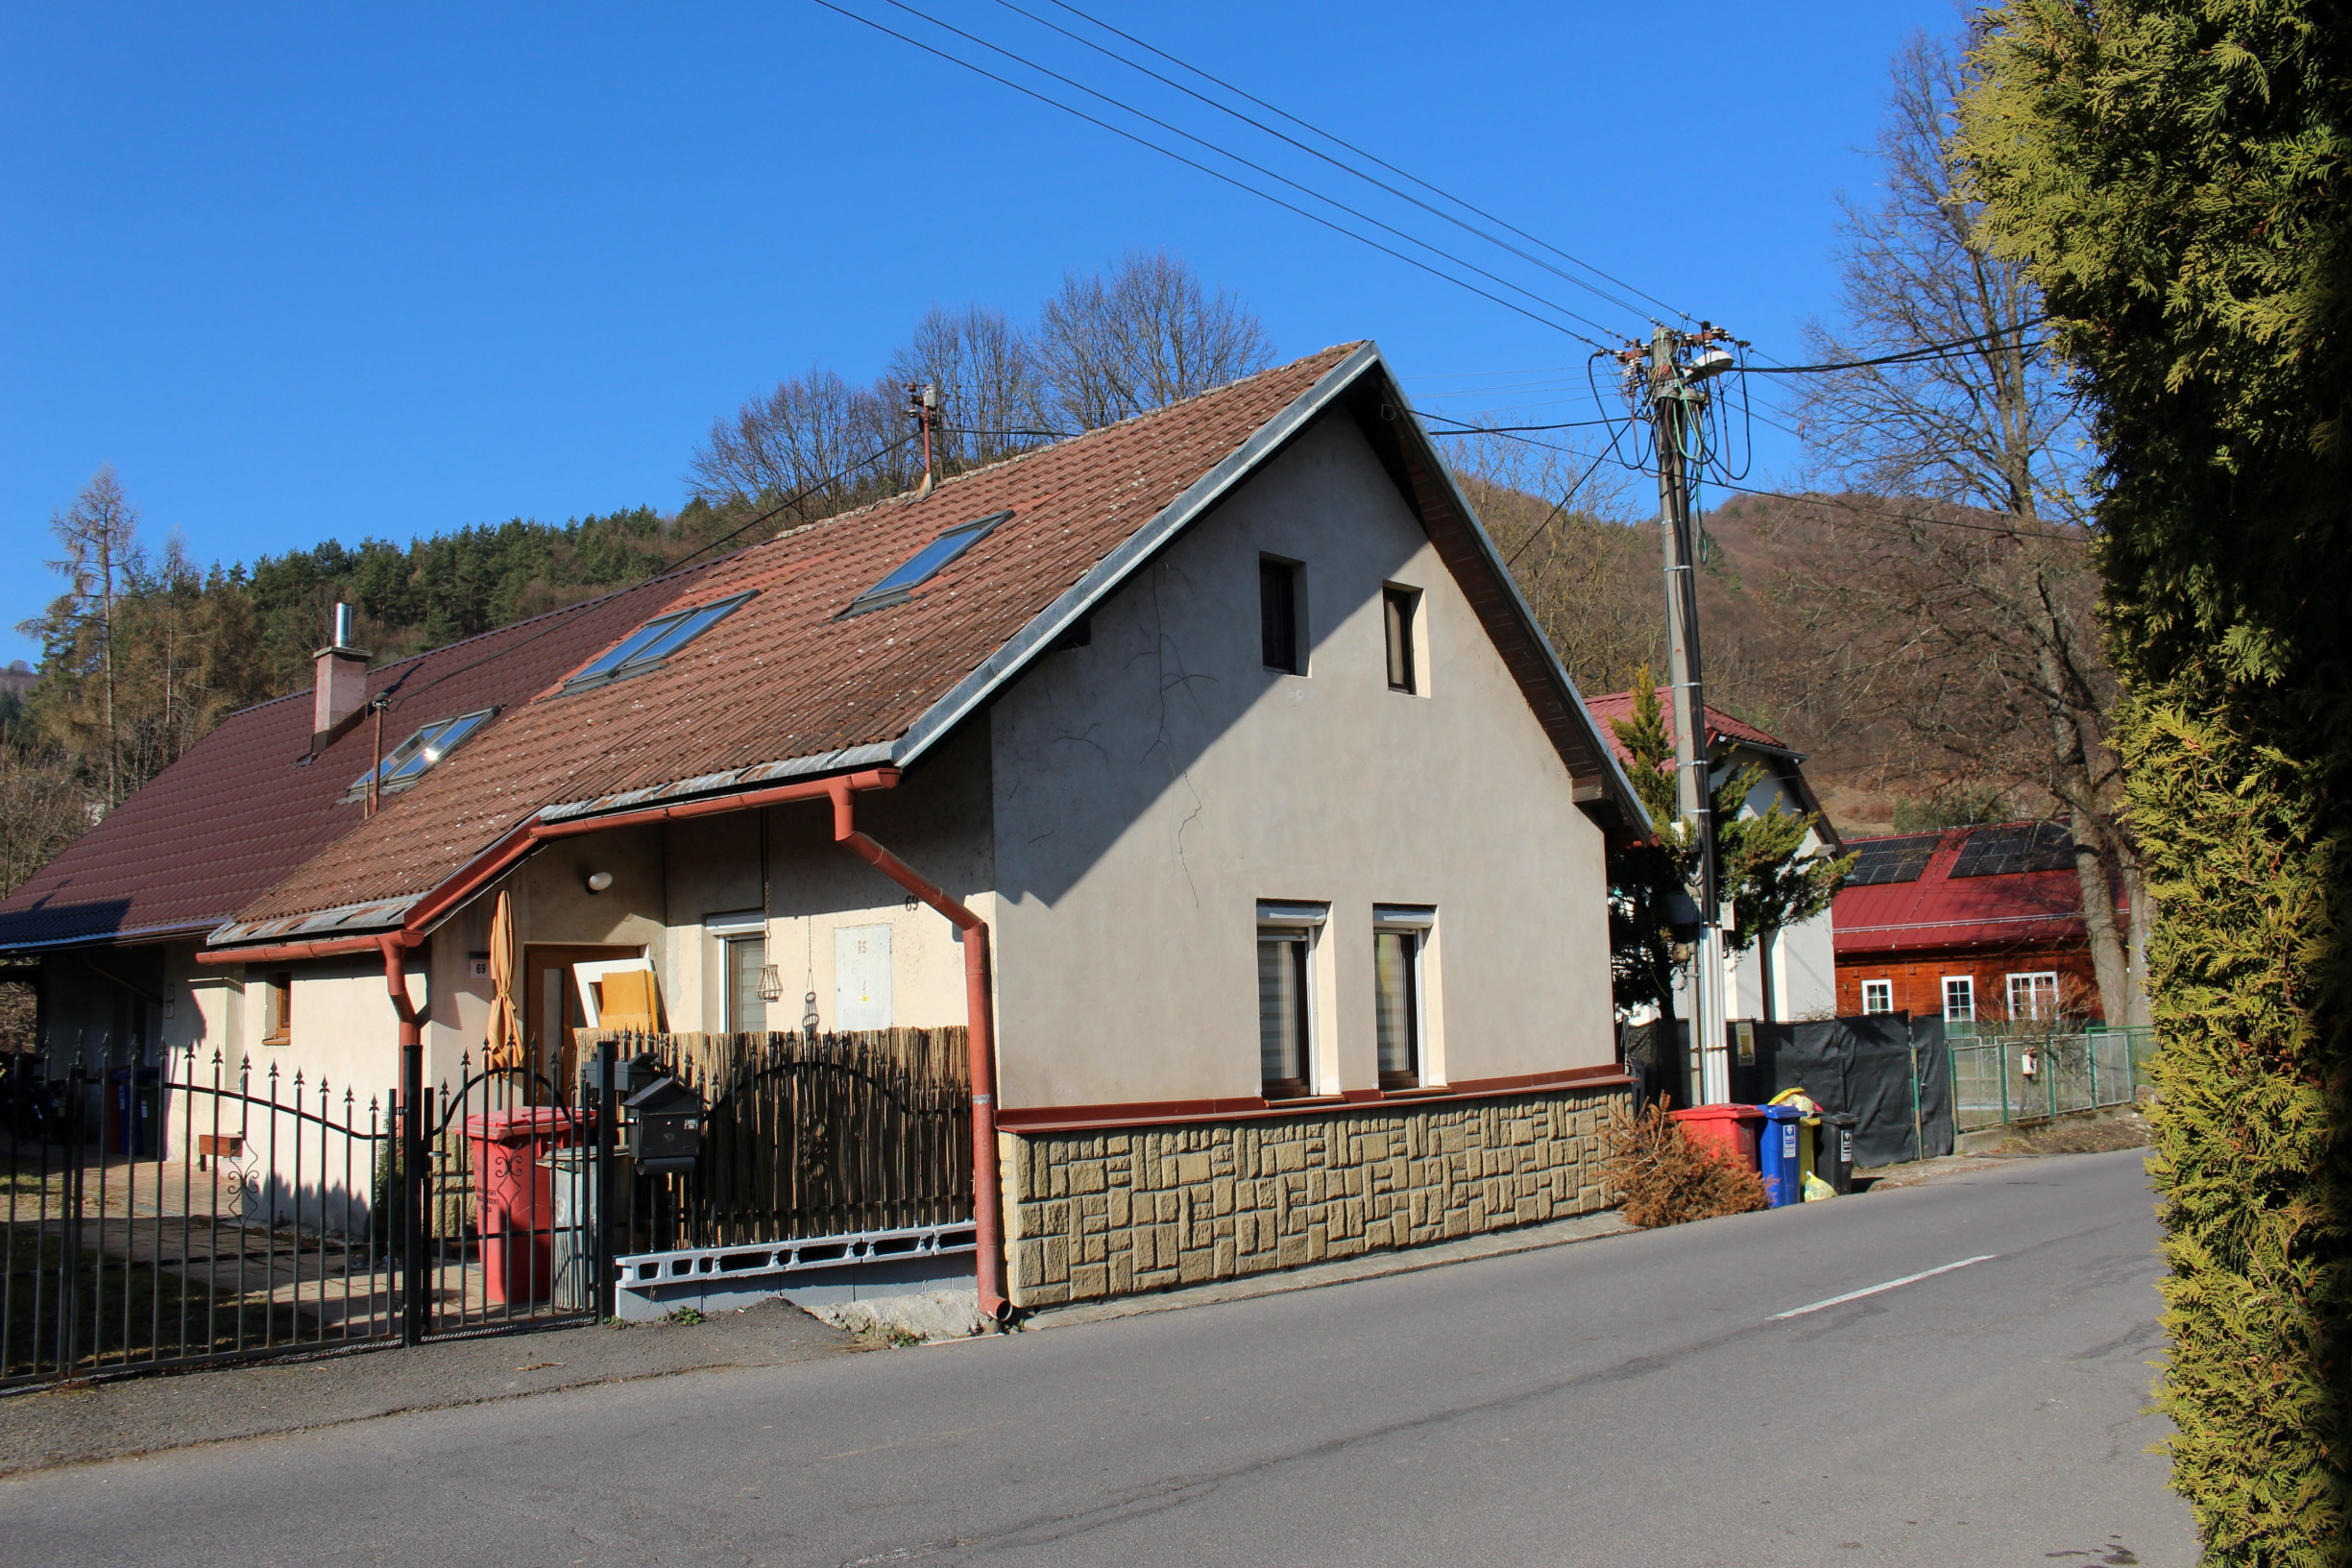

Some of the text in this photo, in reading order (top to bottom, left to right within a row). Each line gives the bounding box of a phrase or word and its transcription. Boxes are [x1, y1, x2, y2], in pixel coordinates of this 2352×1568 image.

[905, 894, 919, 912] 69
[858, 940, 867, 954] RS
[475, 963, 486, 975] 69
